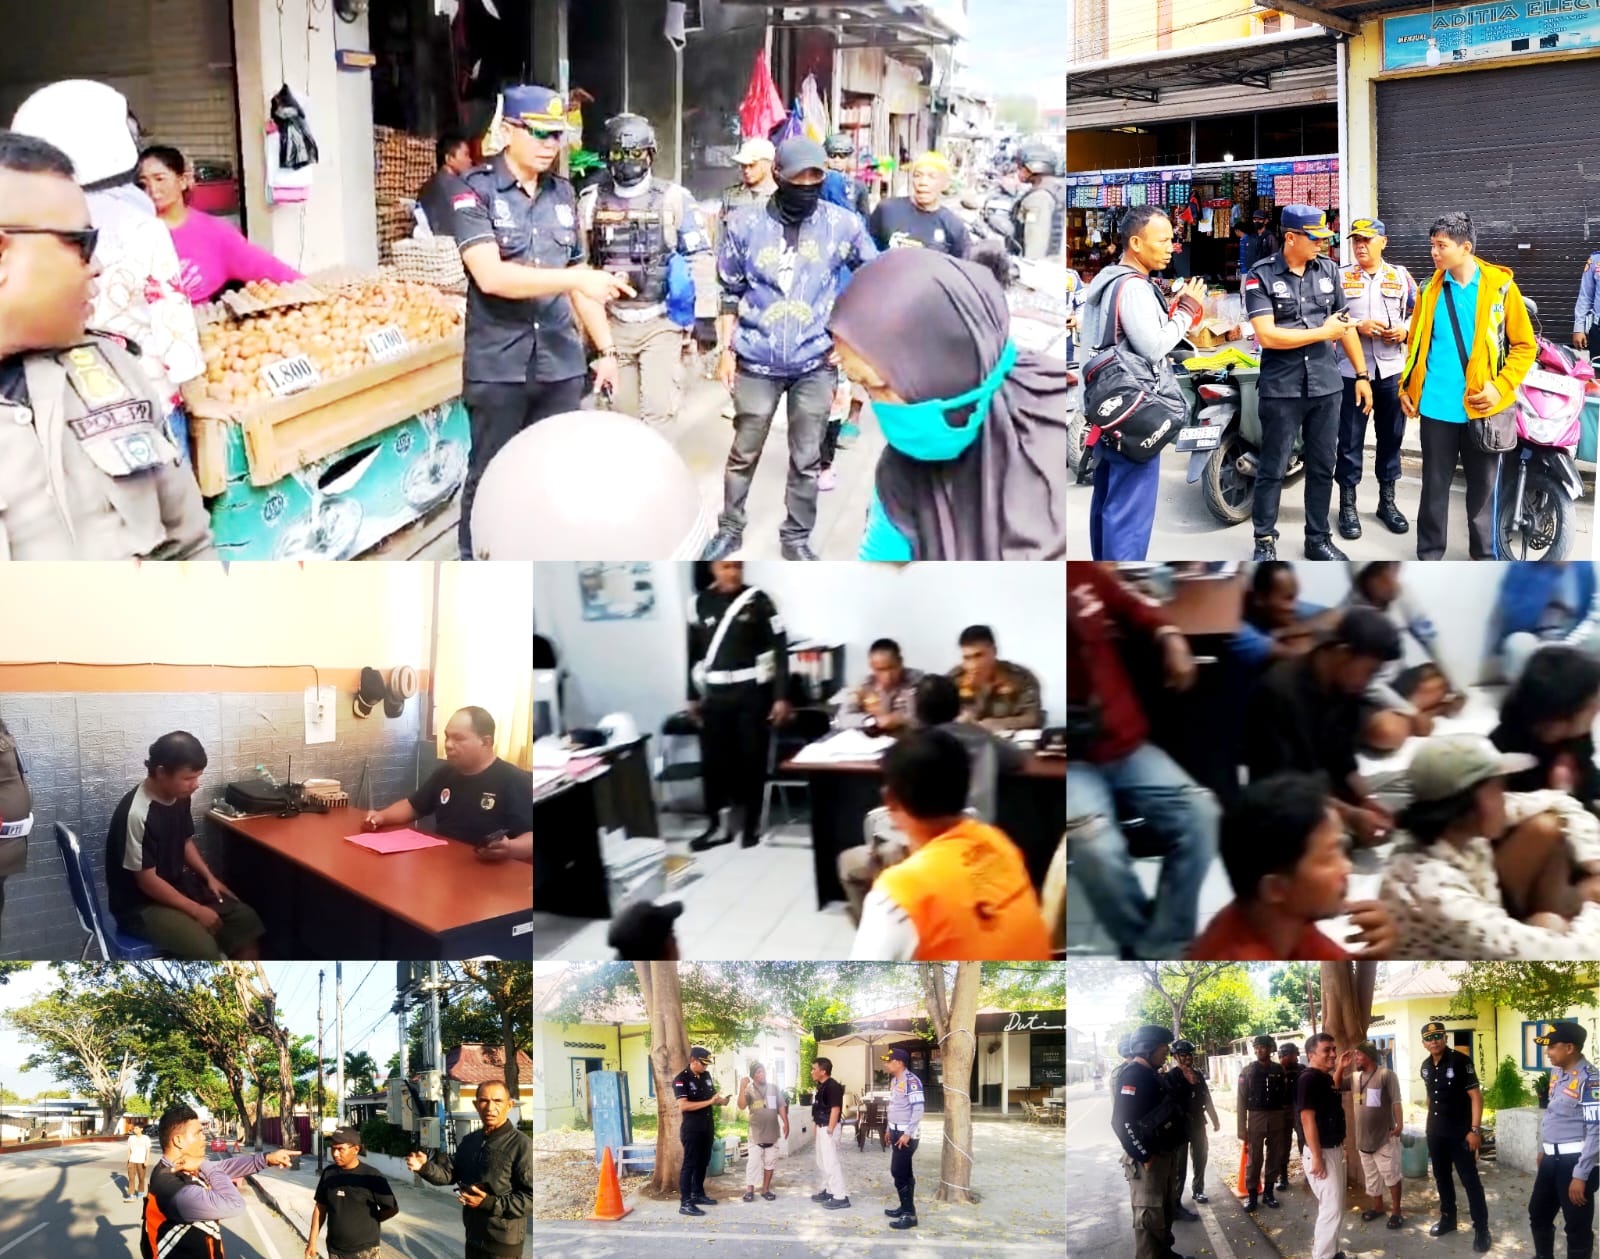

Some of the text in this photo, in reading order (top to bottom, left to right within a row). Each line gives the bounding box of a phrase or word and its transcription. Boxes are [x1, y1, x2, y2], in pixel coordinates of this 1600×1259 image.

[1432, 5, 1518, 30] ADITIA
[369, 329, 402, 354] 1.700
[268, 358, 312, 388] 1.800
